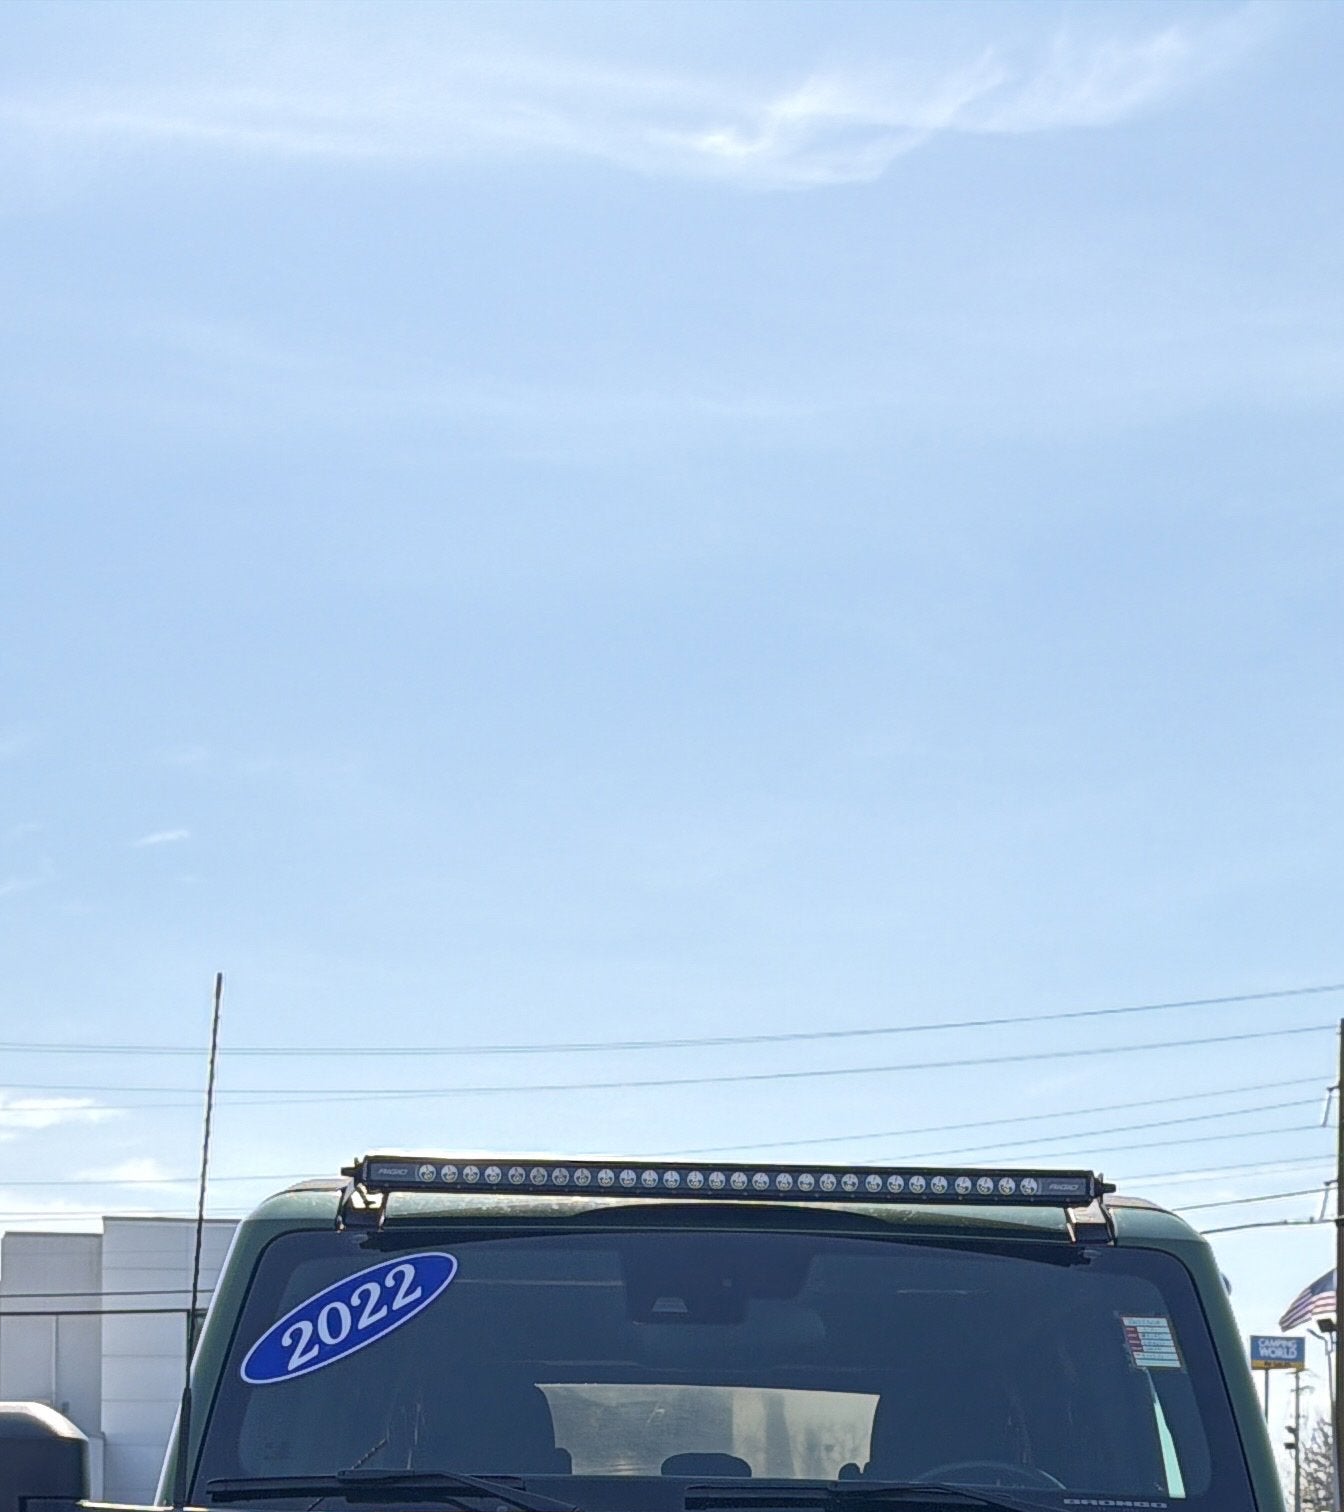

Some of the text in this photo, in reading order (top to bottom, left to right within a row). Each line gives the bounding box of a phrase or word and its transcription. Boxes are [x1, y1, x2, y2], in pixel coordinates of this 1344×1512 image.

[282, 1263, 422, 1371] 2022
[1259, 1347, 1297, 1359] WORLD
[1063, 1498, 1168, 1508] BRONCO
